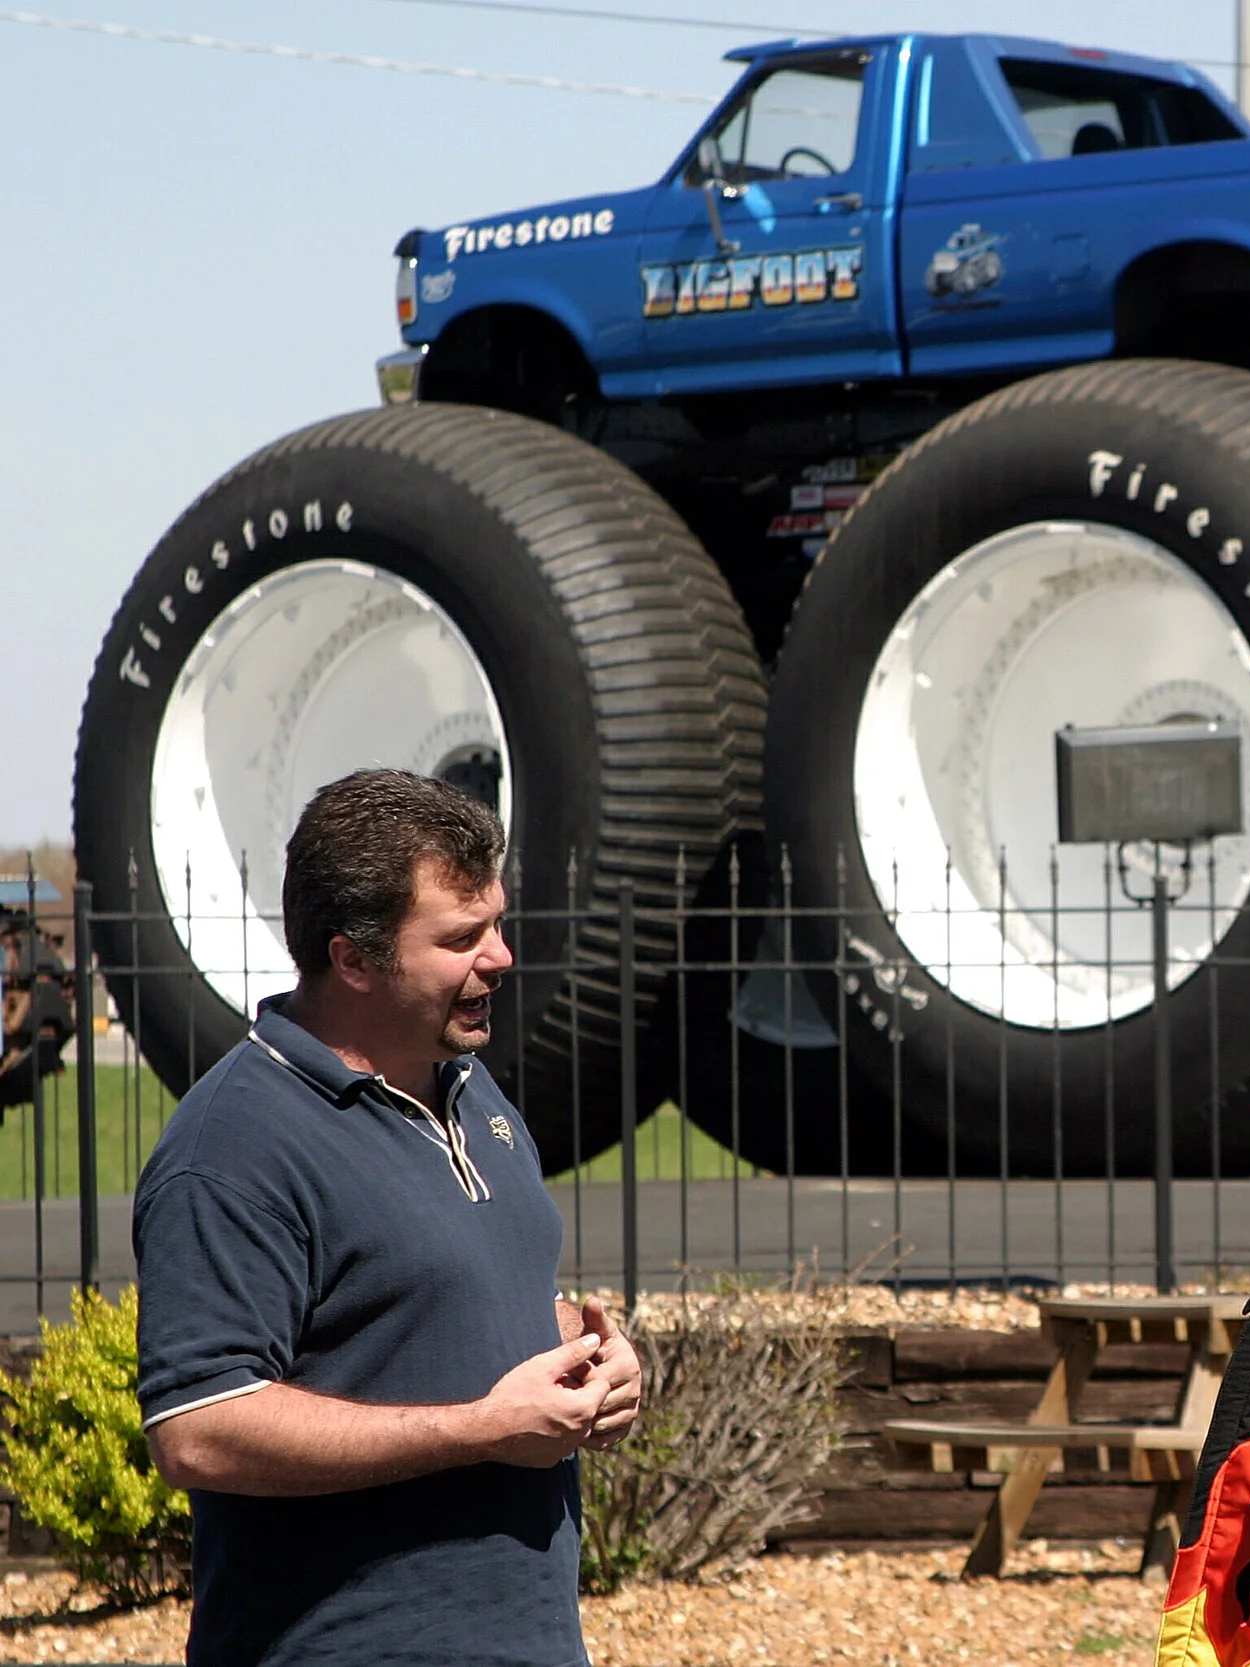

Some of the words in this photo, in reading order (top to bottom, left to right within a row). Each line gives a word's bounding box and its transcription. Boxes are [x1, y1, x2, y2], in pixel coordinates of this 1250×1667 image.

[443, 207, 615, 262] Firestone
[640, 246, 864, 318] BIGFOOT
[119, 499, 354, 688] Firestone
